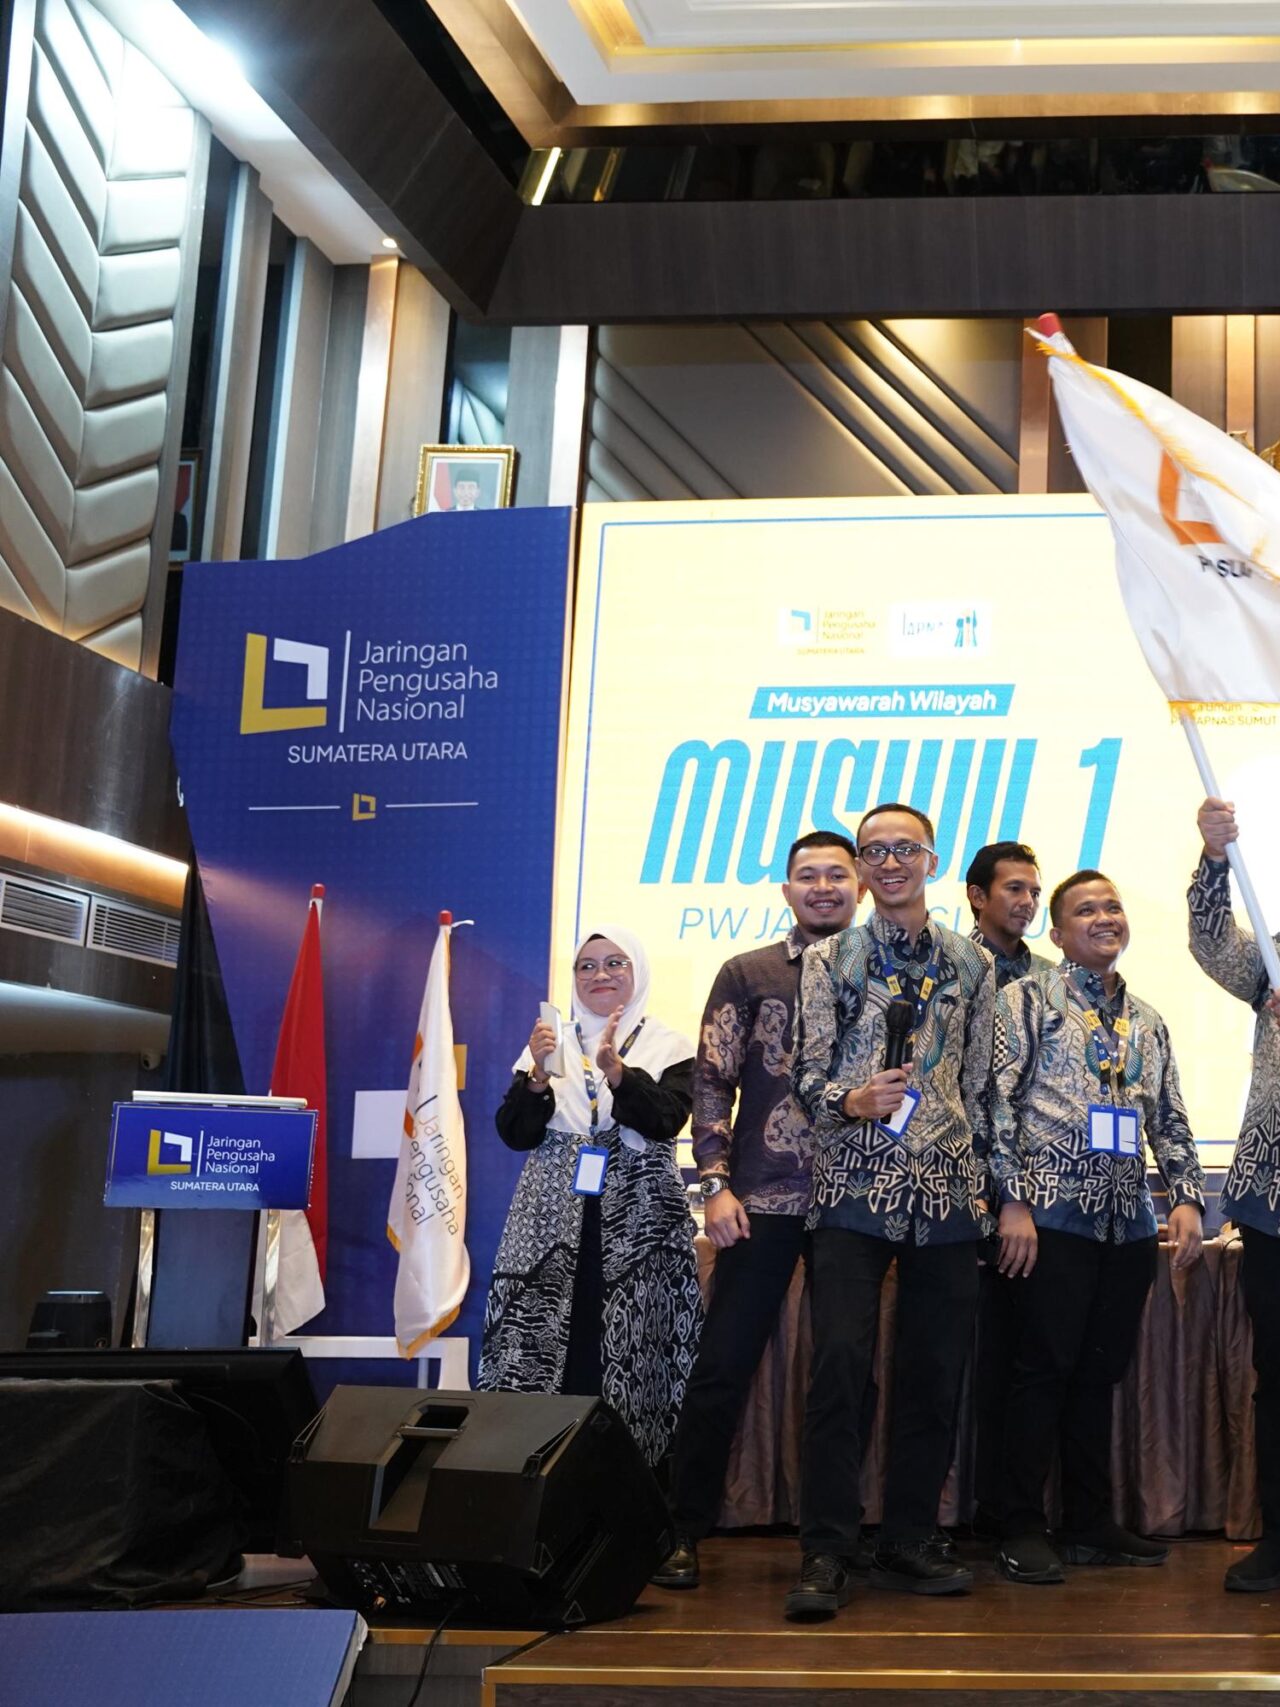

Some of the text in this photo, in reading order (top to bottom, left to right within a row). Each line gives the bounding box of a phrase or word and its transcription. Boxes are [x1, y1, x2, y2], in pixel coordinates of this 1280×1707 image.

[359, 640, 468, 669] Jaringan
[358, 665, 499, 698] Pengusaha
[356, 695, 466, 722] Nasional
[767, 689, 997, 717] Musyawarah Wilayah
[287, 741, 469, 764] SUMATERA UTARA
[678, 907, 750, 940] PW
[206, 1148, 276, 1164] Pengusaha
[207, 1135, 262, 1151] Jaringan
[205, 1161, 259, 1175] Nasional
[417, 1115, 464, 1200] Jaringan
[170, 1180, 260, 1193] SUMATERA UTARA
